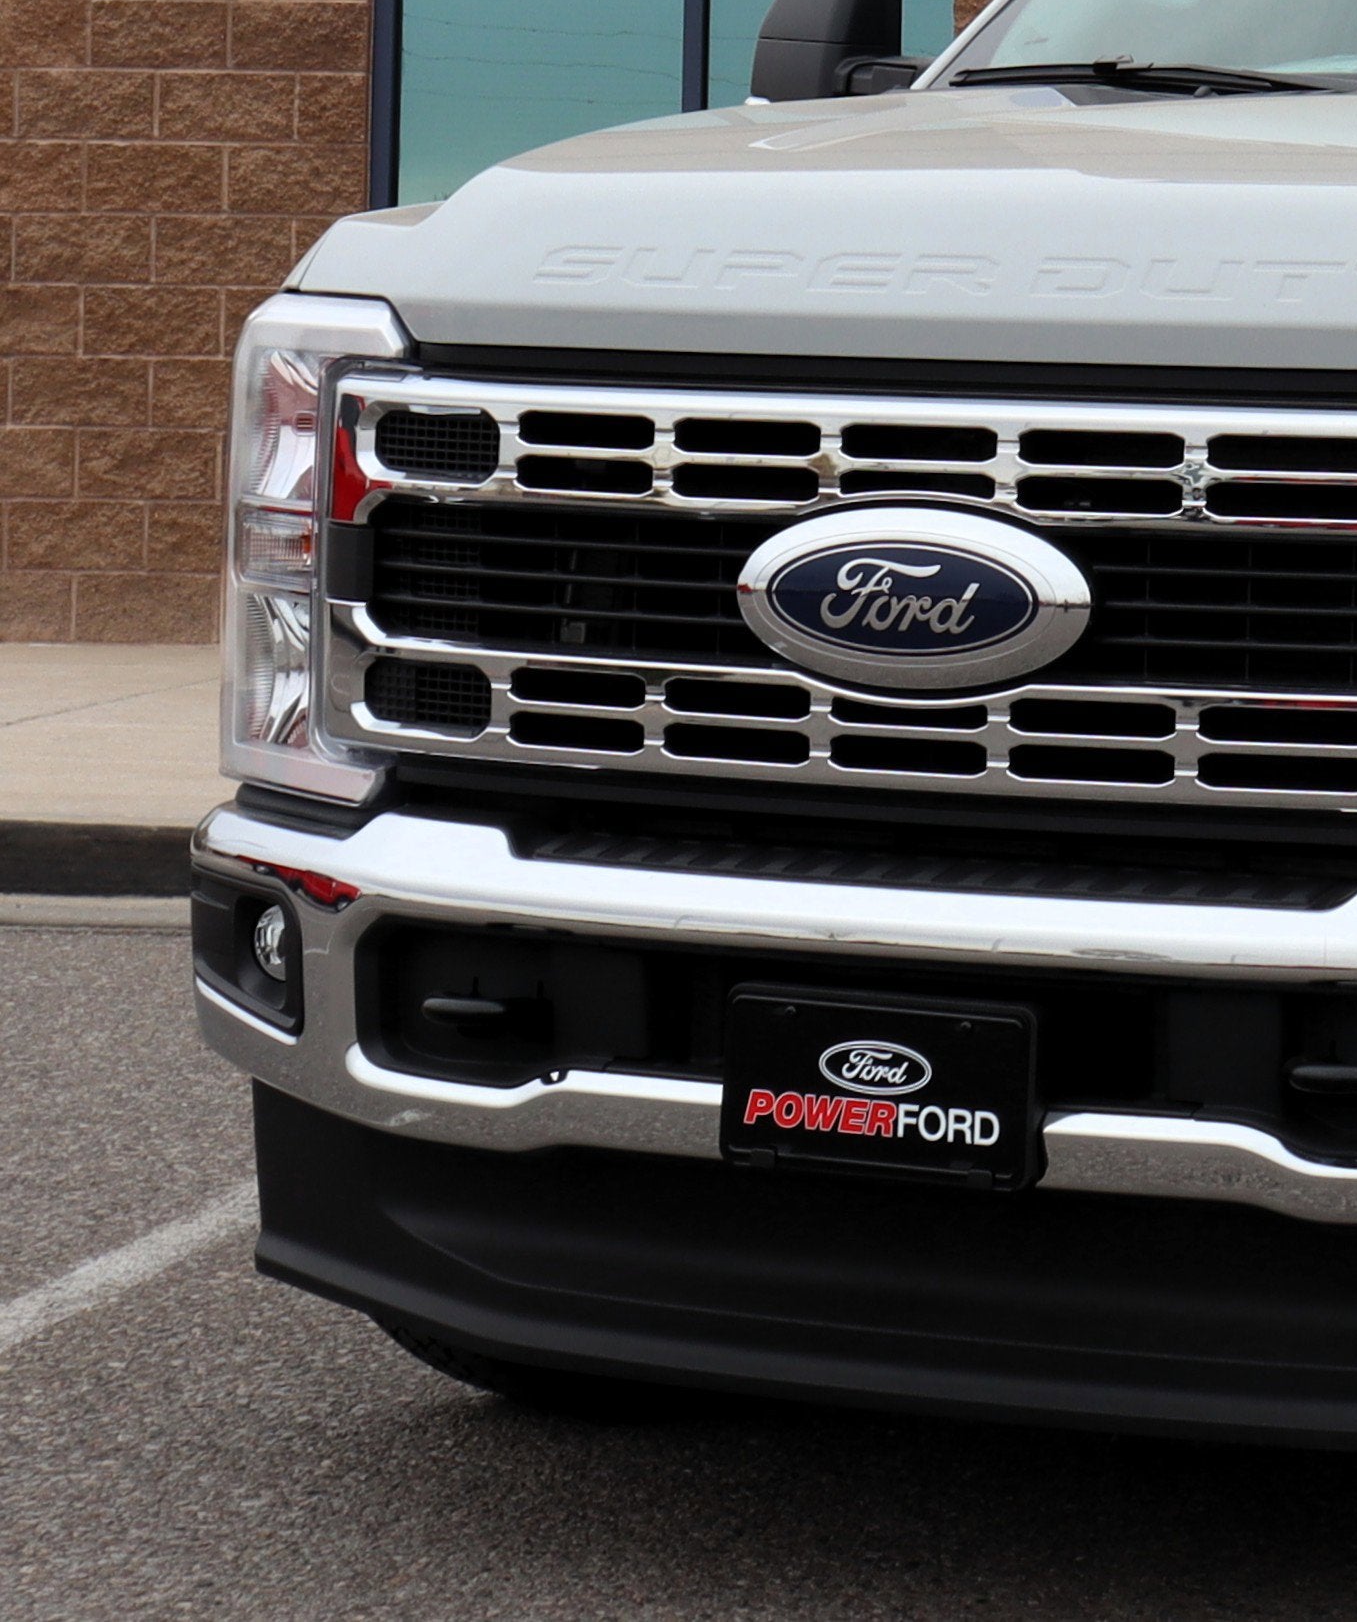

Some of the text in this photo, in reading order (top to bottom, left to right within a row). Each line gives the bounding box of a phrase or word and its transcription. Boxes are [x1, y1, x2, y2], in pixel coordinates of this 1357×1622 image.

[532, 241, 1002, 298] SUPER
[819, 556, 981, 635] Ford
[841, 1049, 908, 1085] Ford
